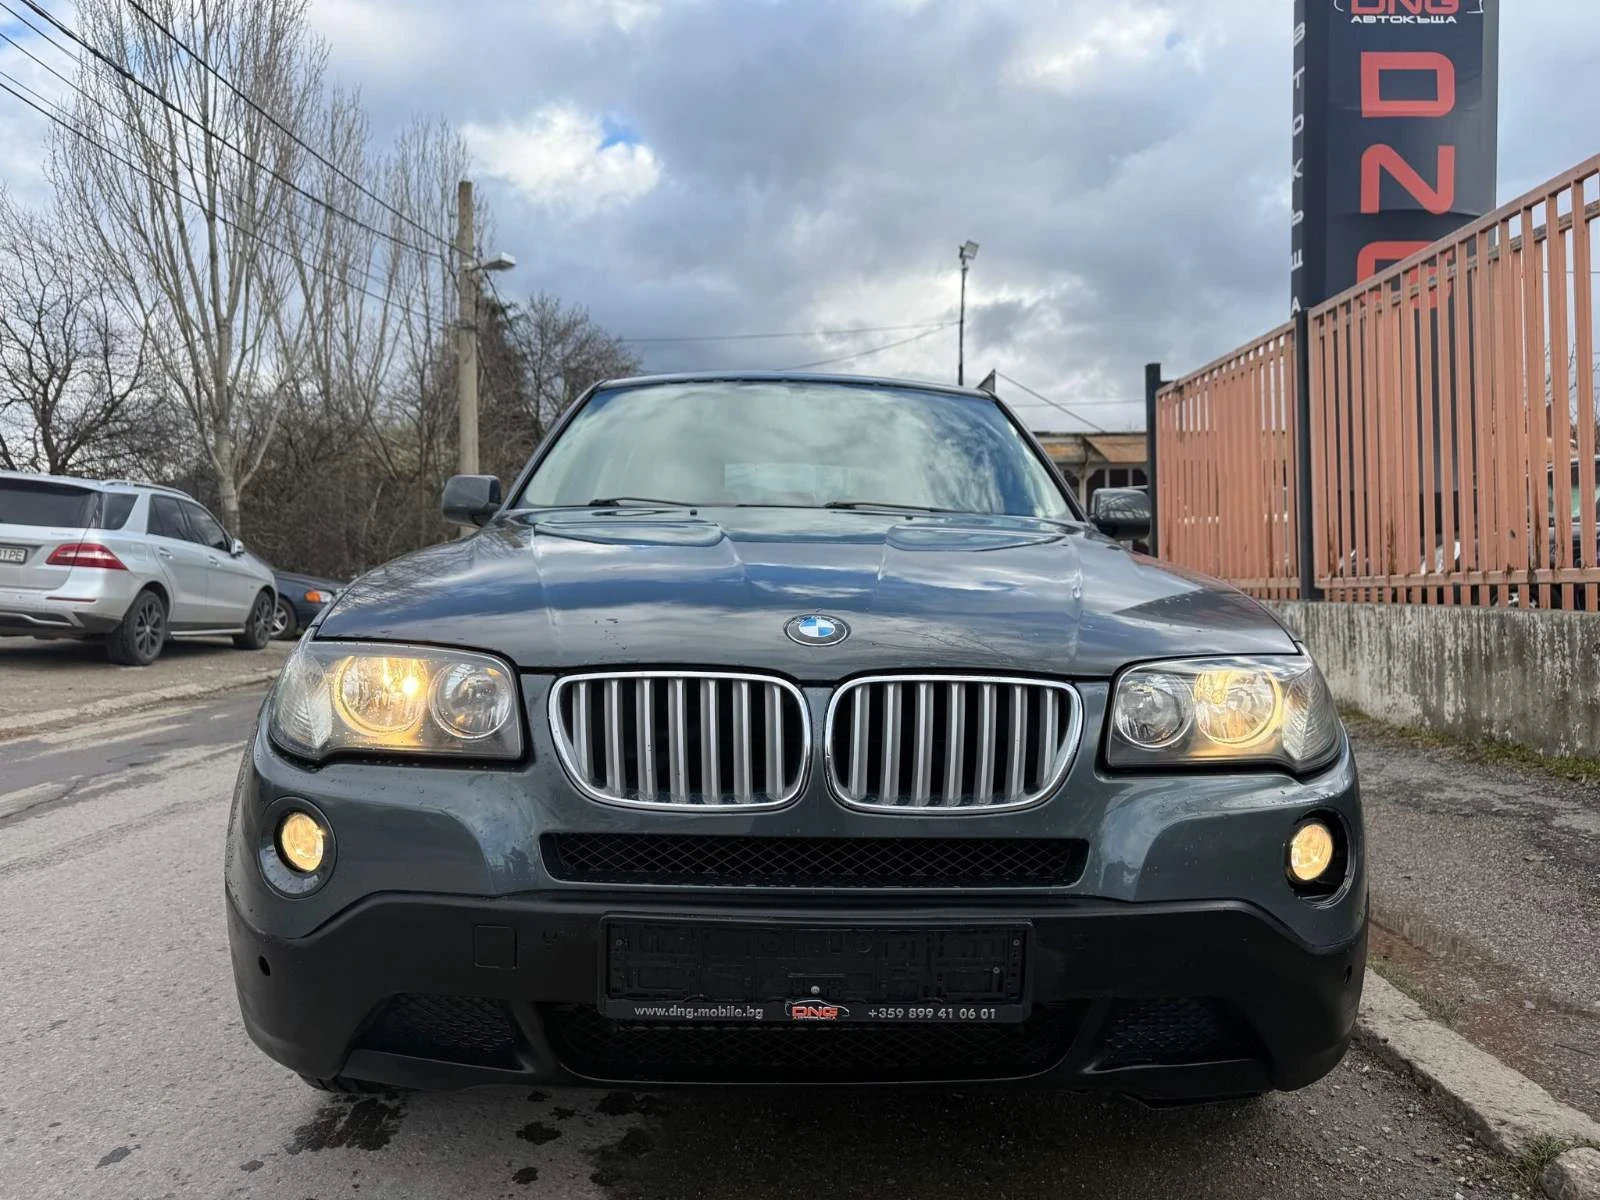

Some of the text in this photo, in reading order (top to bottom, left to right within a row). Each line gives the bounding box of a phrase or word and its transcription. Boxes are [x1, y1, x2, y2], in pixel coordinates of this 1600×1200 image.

[634, 1004, 764, 1019] www.dng.mobile.bg
[792, 1006, 838, 1017] DNG
[868, 1008, 996, 1019] +359 899 41 06 01
